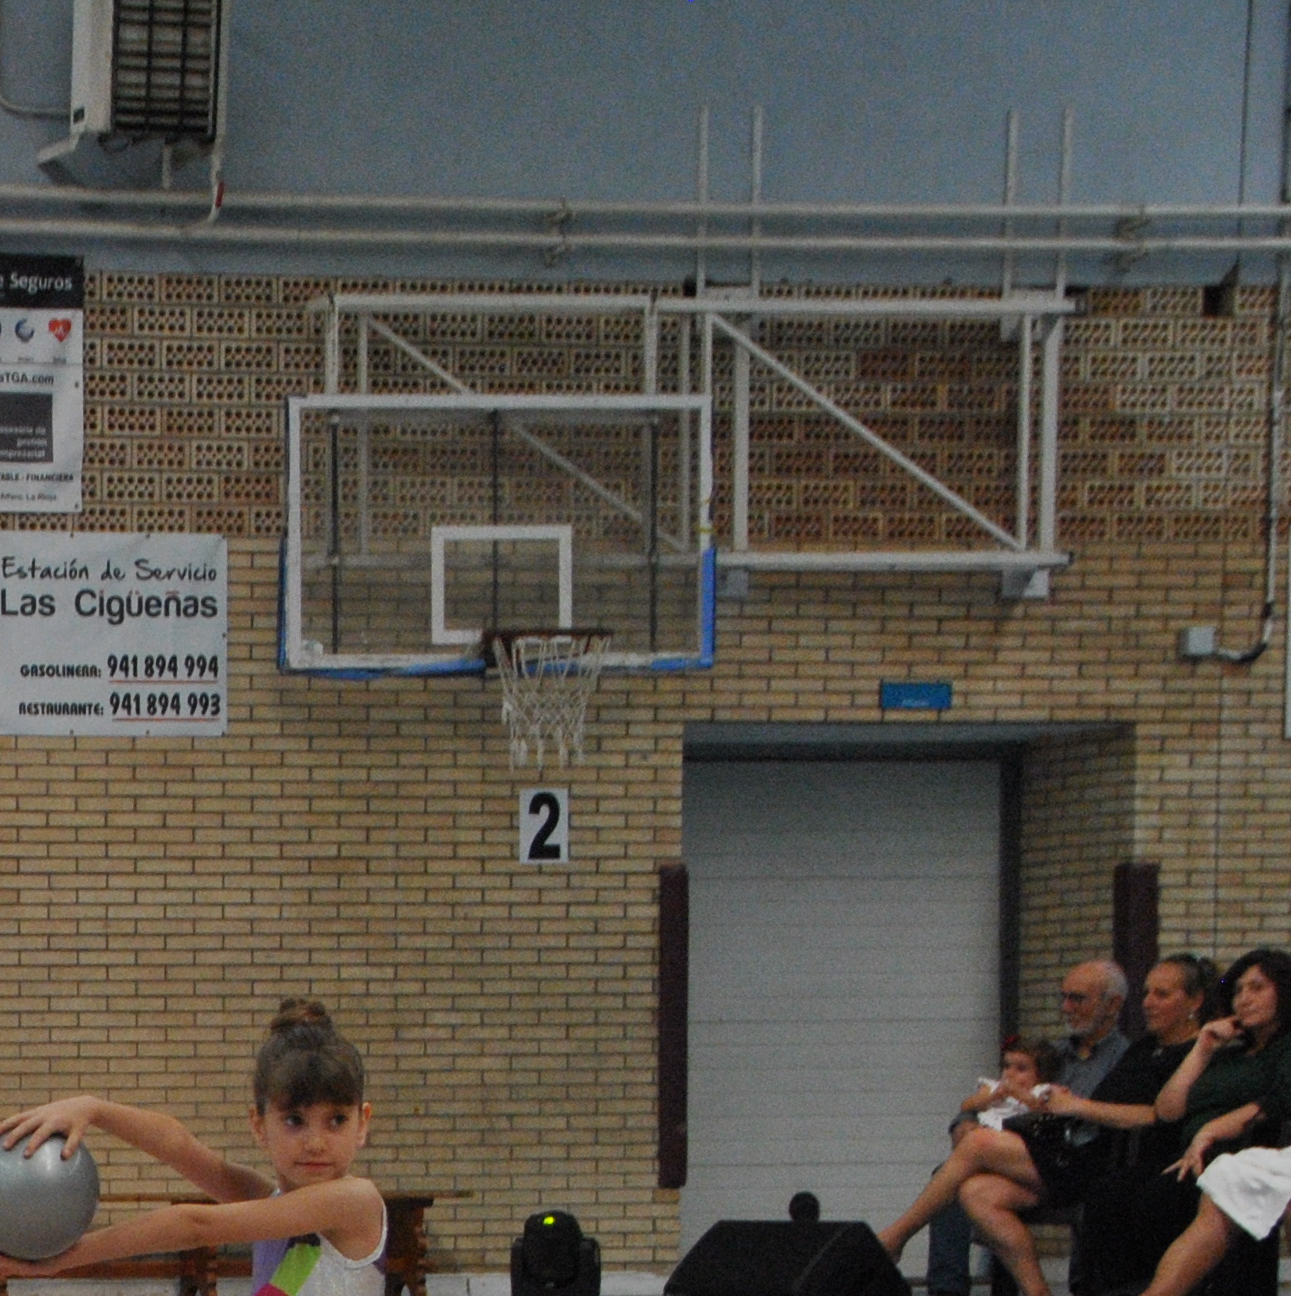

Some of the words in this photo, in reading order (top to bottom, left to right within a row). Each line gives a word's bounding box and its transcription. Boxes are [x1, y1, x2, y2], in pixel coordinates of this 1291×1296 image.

[9, 272, 73, 294] Seguros
[1, 556, 90, 581] Estación
[100, 559, 126, 582] de
[134, 558, 218, 582] Servicio
[0, 588, 57, 617] Las
[74, 588, 219, 626] Cigüeñas
[107, 653, 139, 679] 941
[144, 654, 179, 679] 894
[184, 654, 219, 680] 994
[109, 691, 142, 717] 941
[146, 692, 181, 717] 894
[187, 692, 222, 718] 993
[527, 791, 561, 860] 2
